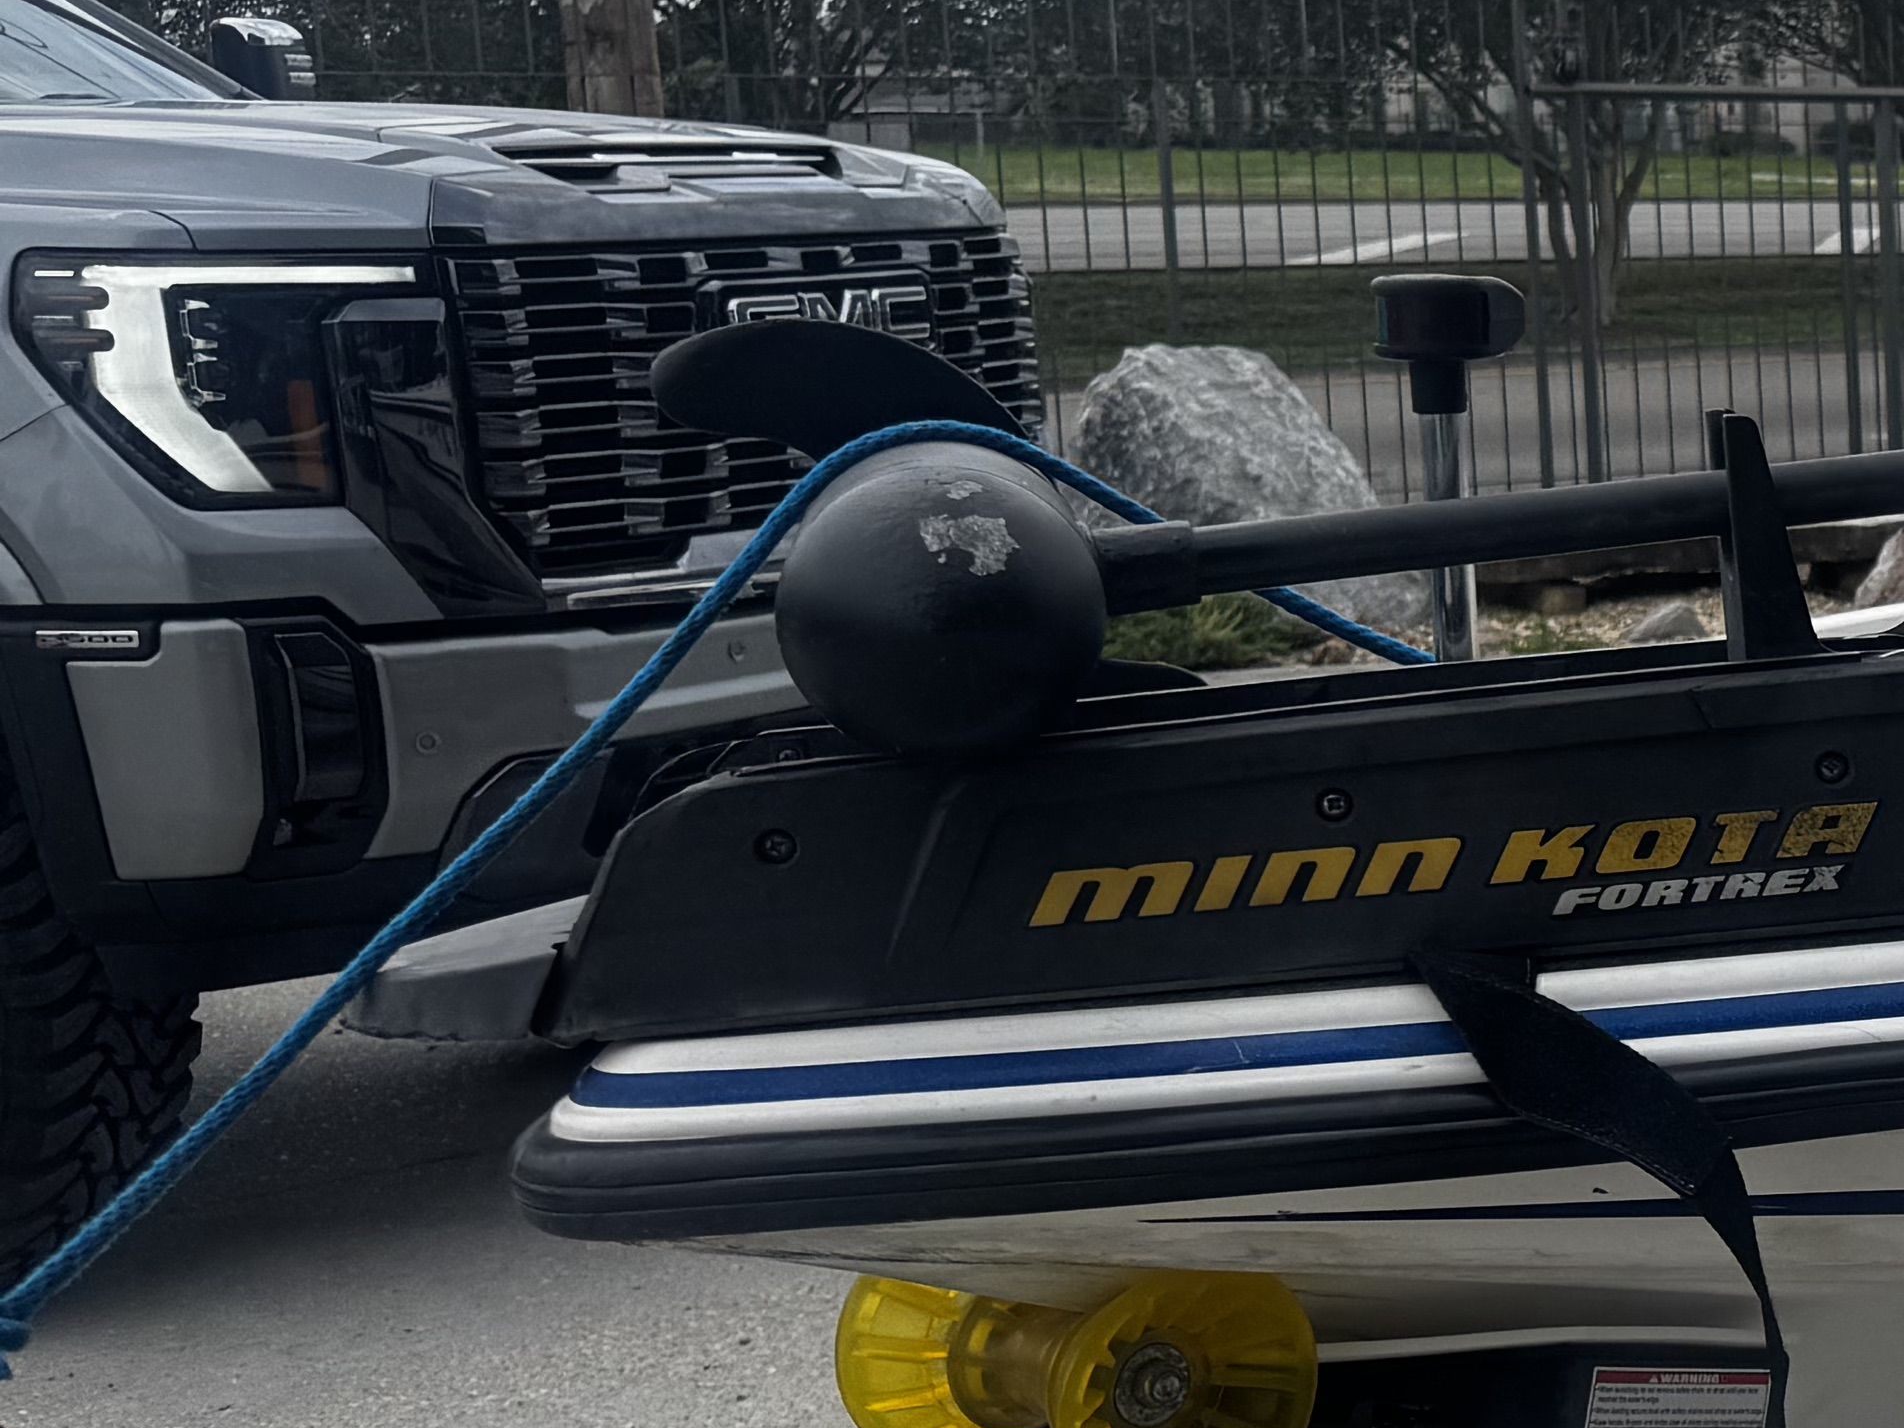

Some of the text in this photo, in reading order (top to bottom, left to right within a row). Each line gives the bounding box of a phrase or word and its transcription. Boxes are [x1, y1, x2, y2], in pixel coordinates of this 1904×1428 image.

[1027, 799, 1880, 928] MINN KOTA
[1551, 863, 1845, 918] FORTREX
[1659, 1373, 1720, 1385] WARNING
